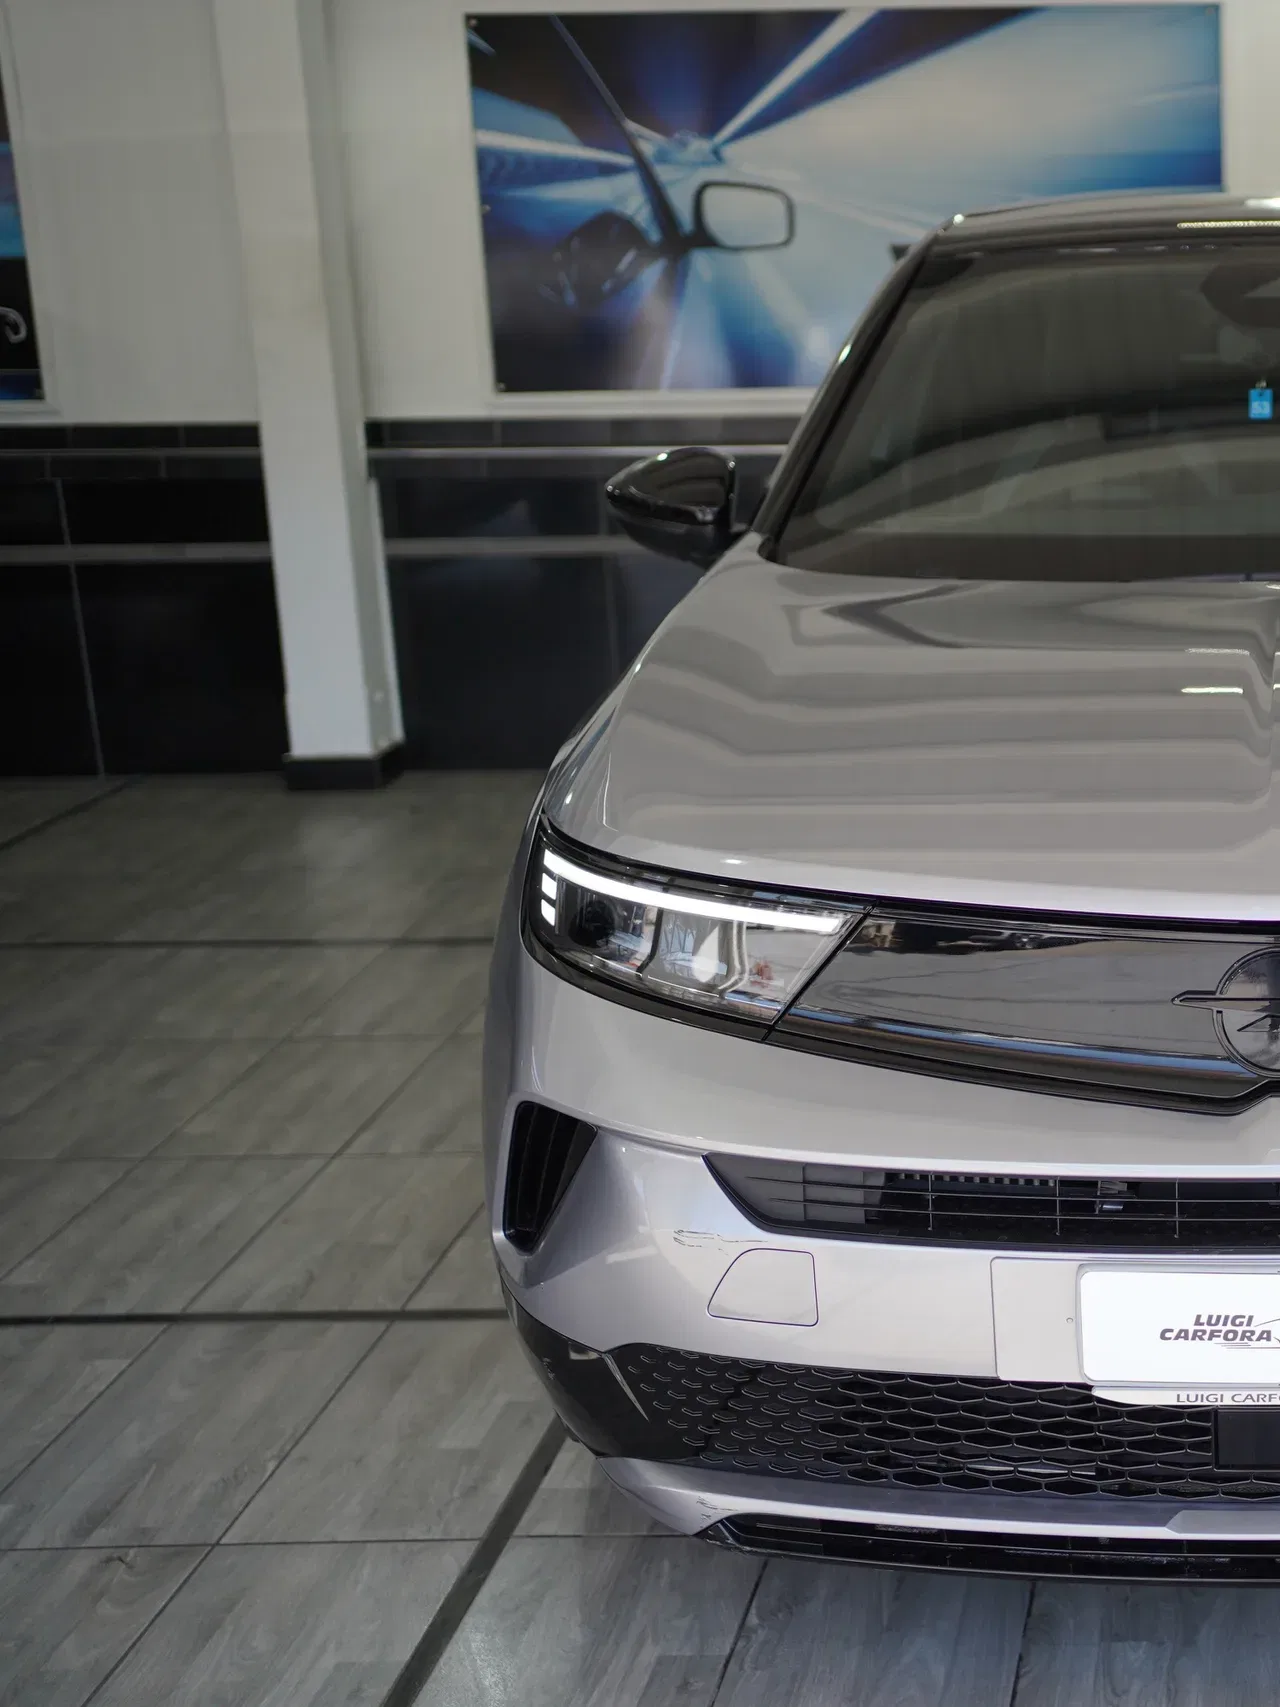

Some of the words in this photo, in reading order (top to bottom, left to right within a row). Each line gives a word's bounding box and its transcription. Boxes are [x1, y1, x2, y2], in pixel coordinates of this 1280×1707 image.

[1194, 1314, 1255, 1327] LUIGI
[1159, 1328, 1272, 1341] CARFORA
[1176, 1393, 1224, 1403] LUIGI
